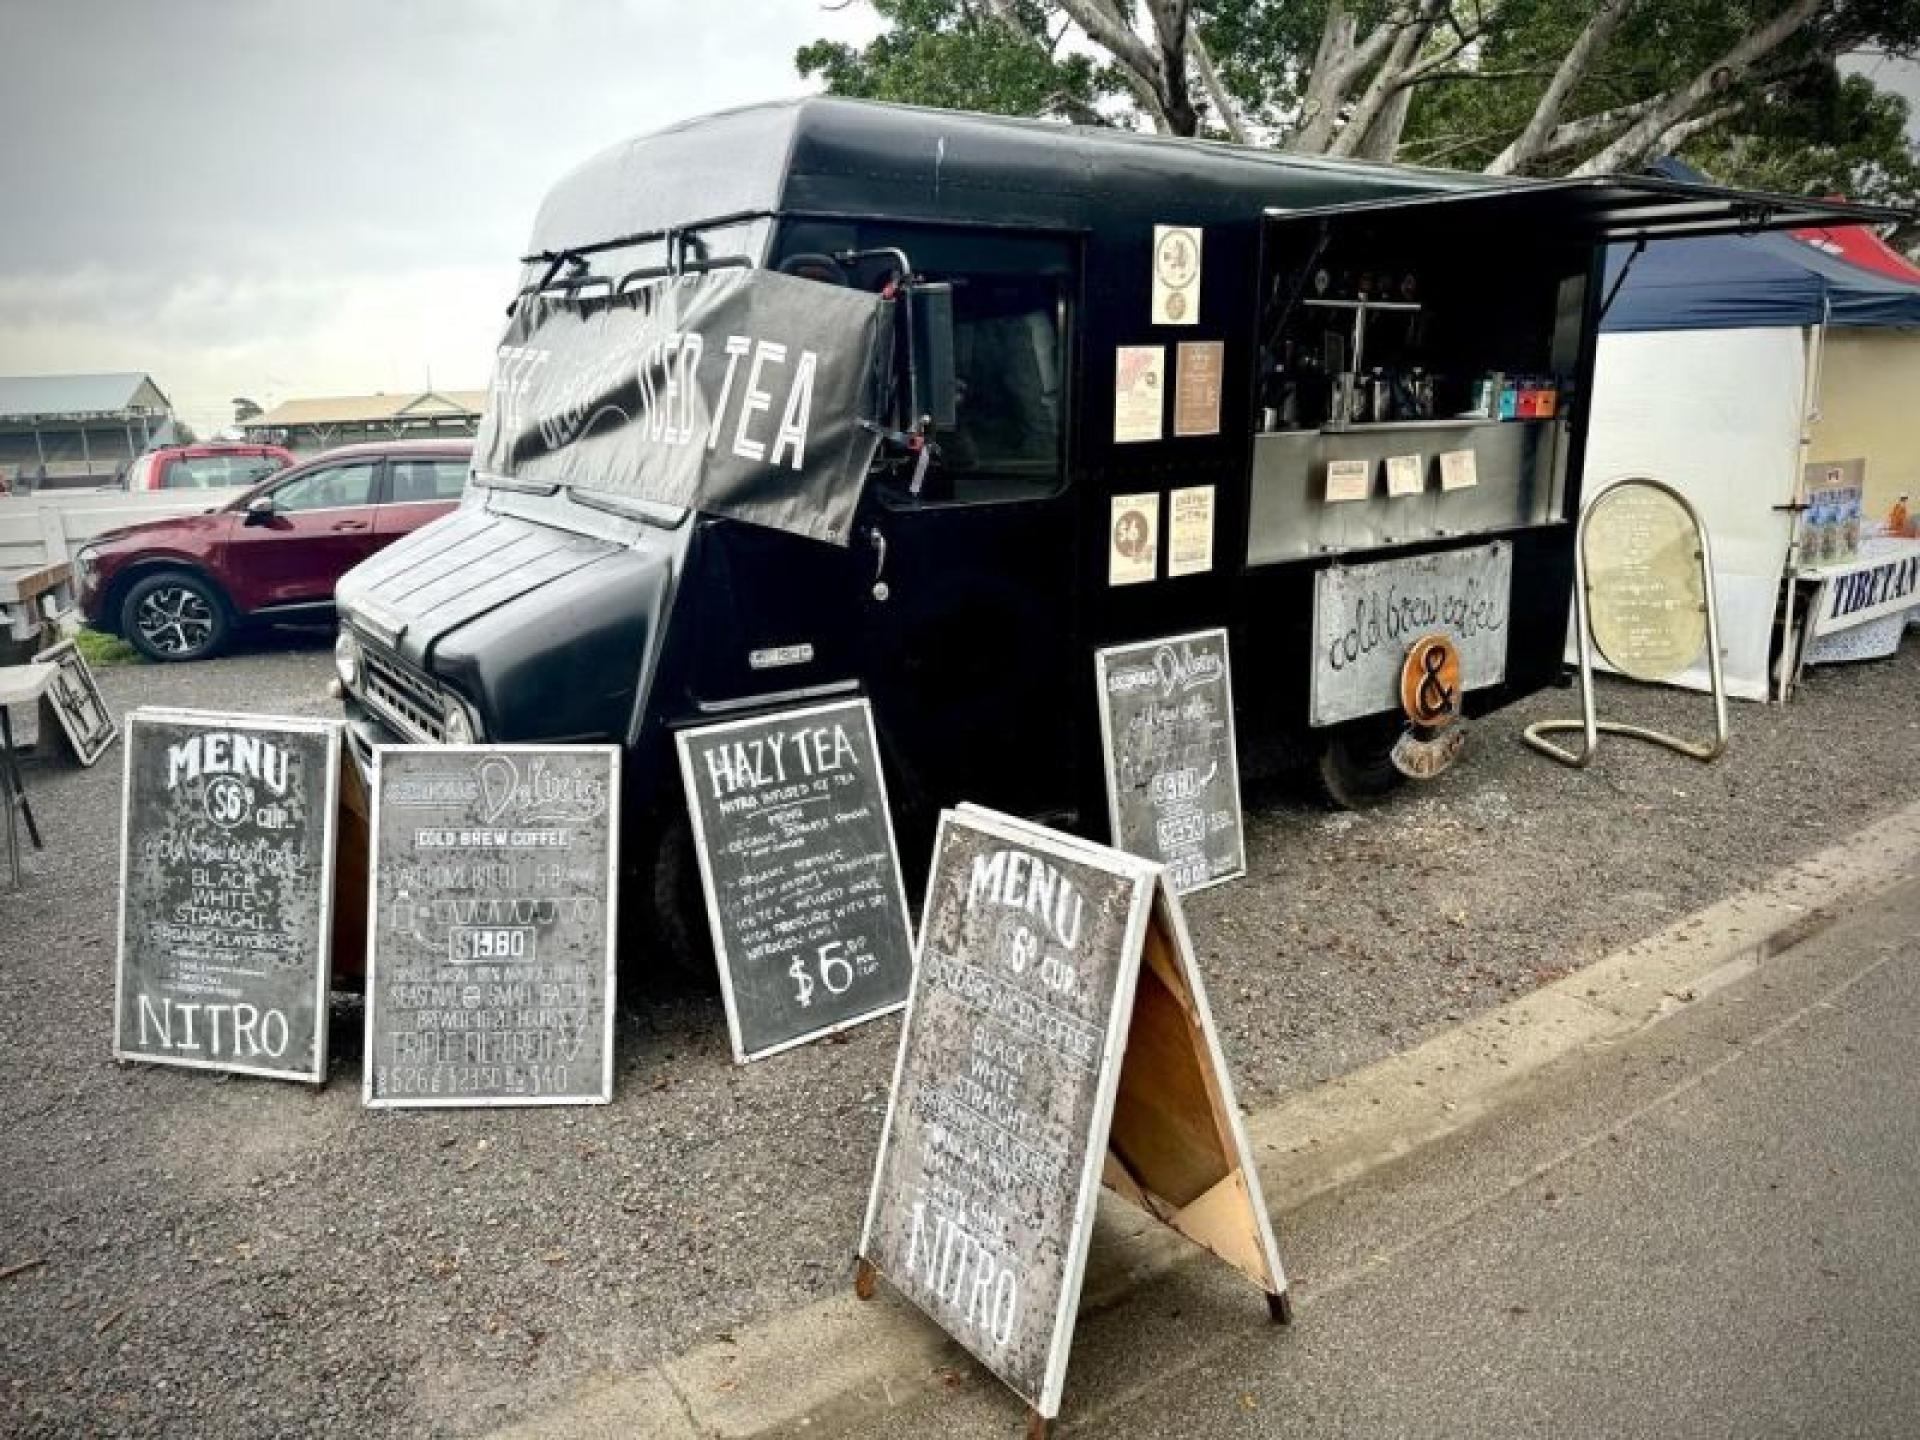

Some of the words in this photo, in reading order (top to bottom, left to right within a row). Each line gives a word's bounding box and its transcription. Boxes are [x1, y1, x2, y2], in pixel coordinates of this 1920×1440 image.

[707, 335, 817, 470] TEA
[1417, 644, 1453, 719] &
[167, 732, 290, 795] MENU
[704, 731, 786, 798] HAZY
[791, 724, 858, 776] TEA
[418, 831, 455, 847] COLD
[460, 831, 507, 847] BREW
[511, 831, 569, 847] COFFEE
[191, 868, 260, 889] BLACK
[191, 887, 256, 911] WHITE
[966, 851, 1083, 950] MENU
[139, 994, 290, 1058] NITRO
[906, 1202, 1018, 1347] NITRO
